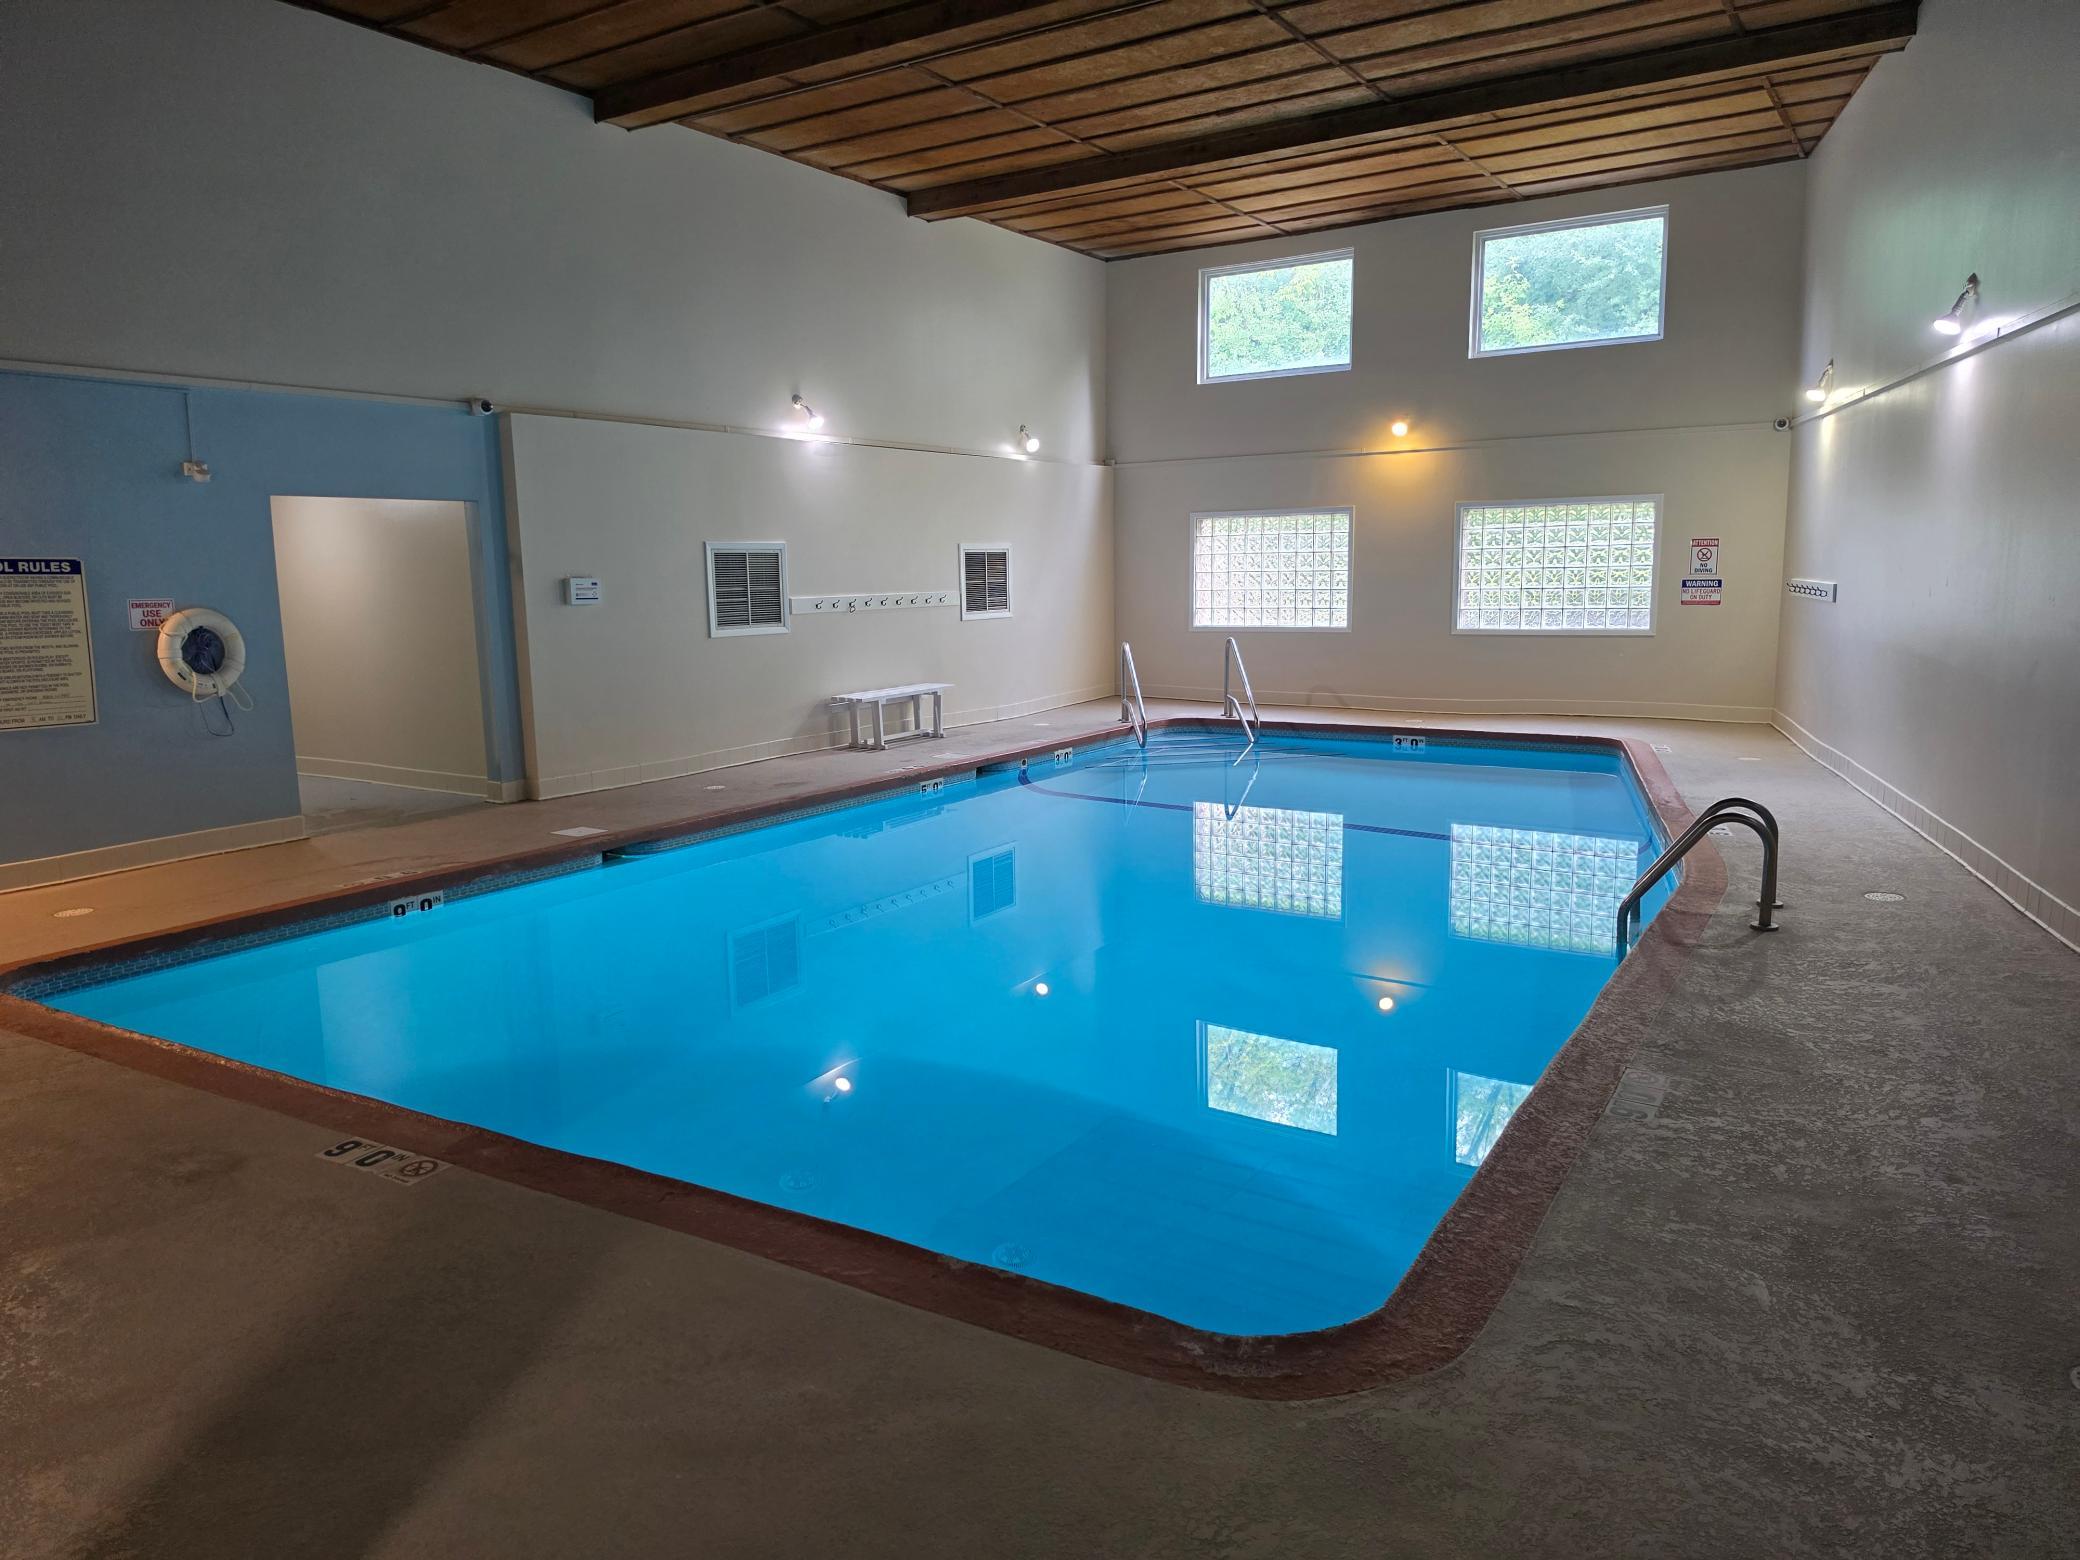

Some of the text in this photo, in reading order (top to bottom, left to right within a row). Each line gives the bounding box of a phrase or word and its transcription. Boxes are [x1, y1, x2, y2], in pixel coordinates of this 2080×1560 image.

[18, 562, 71, 573] RULES
[142, 609, 162, 618] USE
[406, 901, 415, 910] FT
[323, 1140, 363, 1157] 9
[355, 1150, 396, 1167] 0
